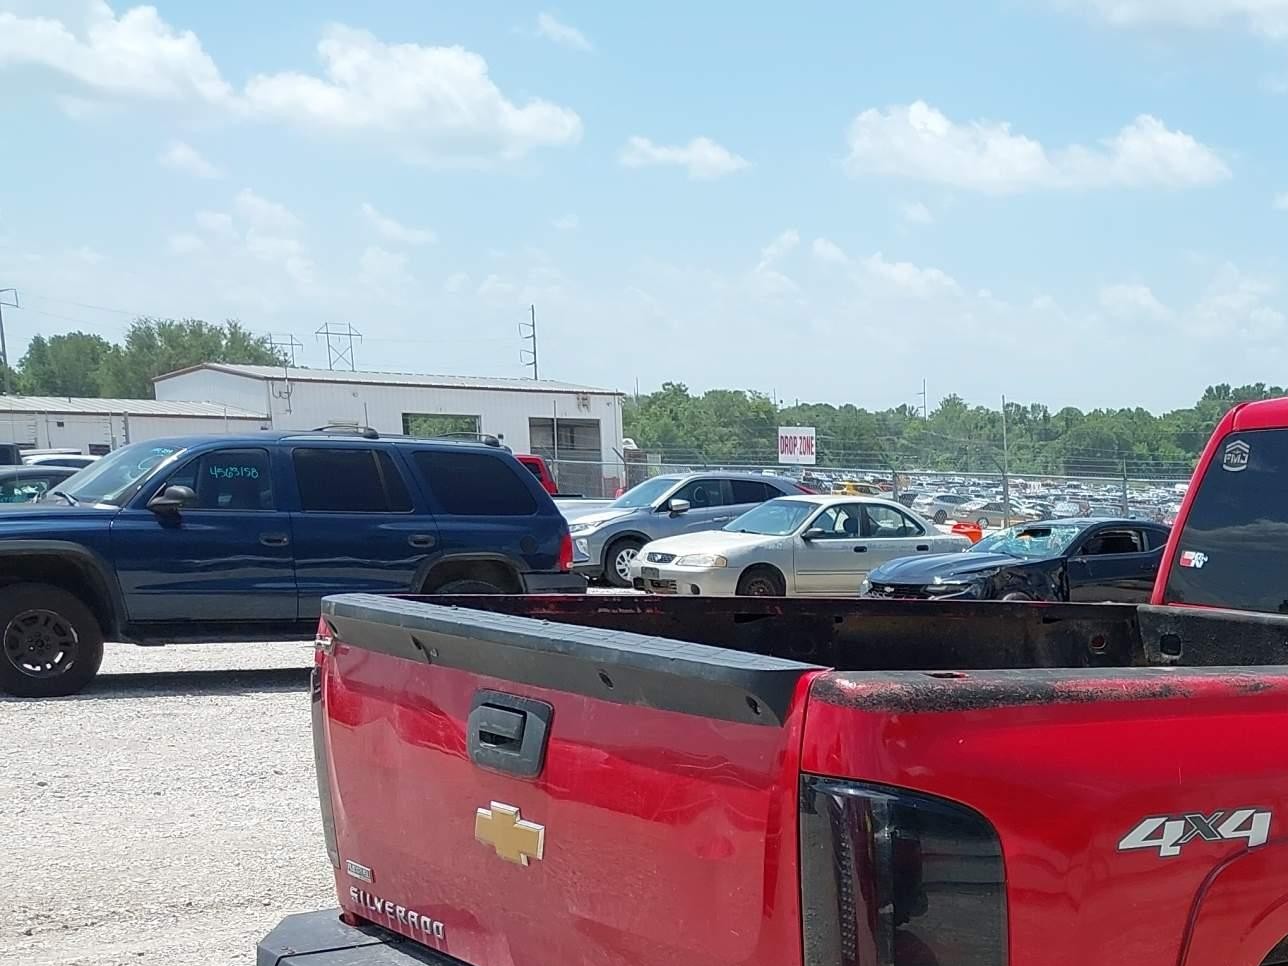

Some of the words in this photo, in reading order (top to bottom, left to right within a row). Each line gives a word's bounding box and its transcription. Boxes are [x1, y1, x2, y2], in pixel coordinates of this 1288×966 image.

[780, 435, 797, 455] DROP
[799, 435, 814, 456] ZONE
[209, 465, 259, 479] 4563158
[349, 886, 444, 939] SILVERADO
